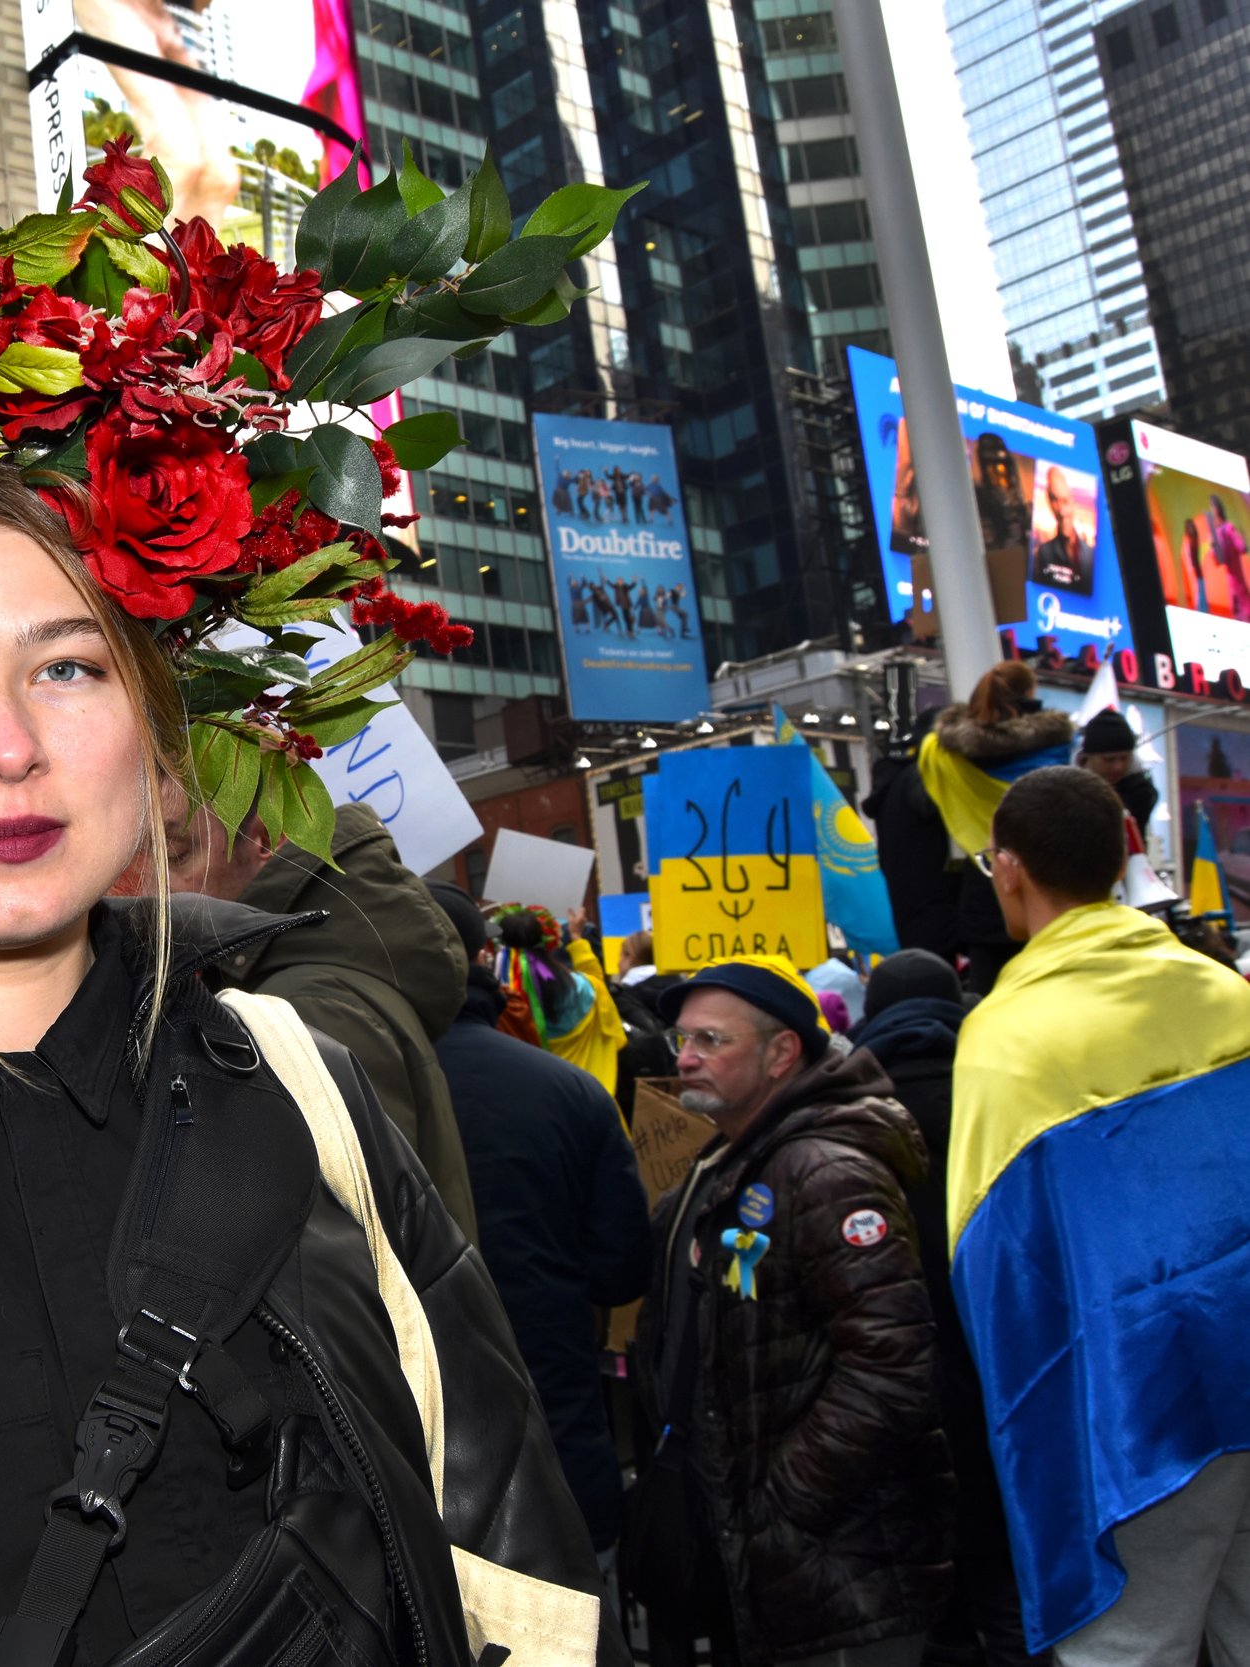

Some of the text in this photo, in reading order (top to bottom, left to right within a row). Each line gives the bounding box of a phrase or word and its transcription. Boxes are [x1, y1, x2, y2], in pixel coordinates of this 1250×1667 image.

[41, 44, 67, 195] EXPRESS
[1111, 466, 1133, 484] LG
[558, 526, 683, 560] Doubtfire
